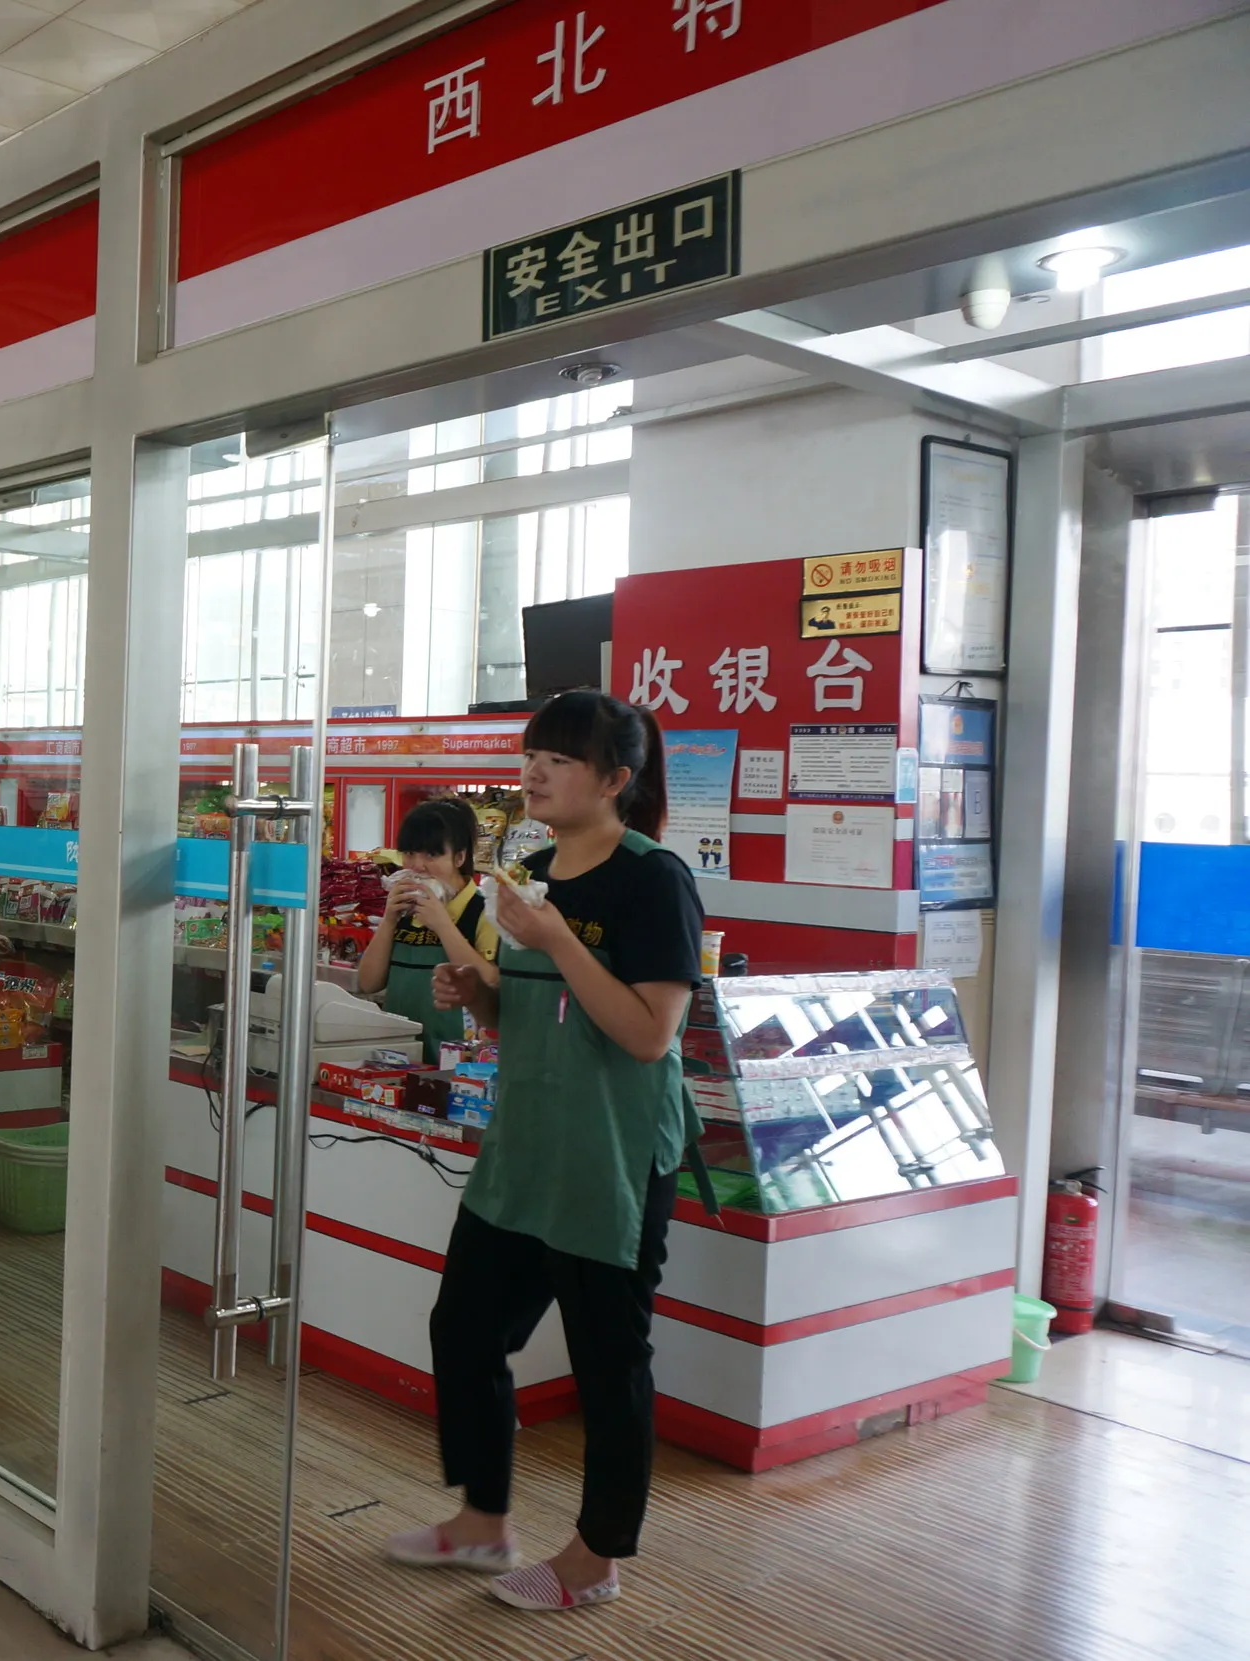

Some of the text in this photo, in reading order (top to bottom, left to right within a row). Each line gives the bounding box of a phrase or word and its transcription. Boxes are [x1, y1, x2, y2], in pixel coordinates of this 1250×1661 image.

[505, 195, 713, 298] 安全出口
[535, 259, 676, 316] EXIT
[840, 557, 896, 576] 请勿吸烟
[629, 639, 873, 714] 收银台
[326, 737, 512, 753] 商超市 1997 Supermarket
